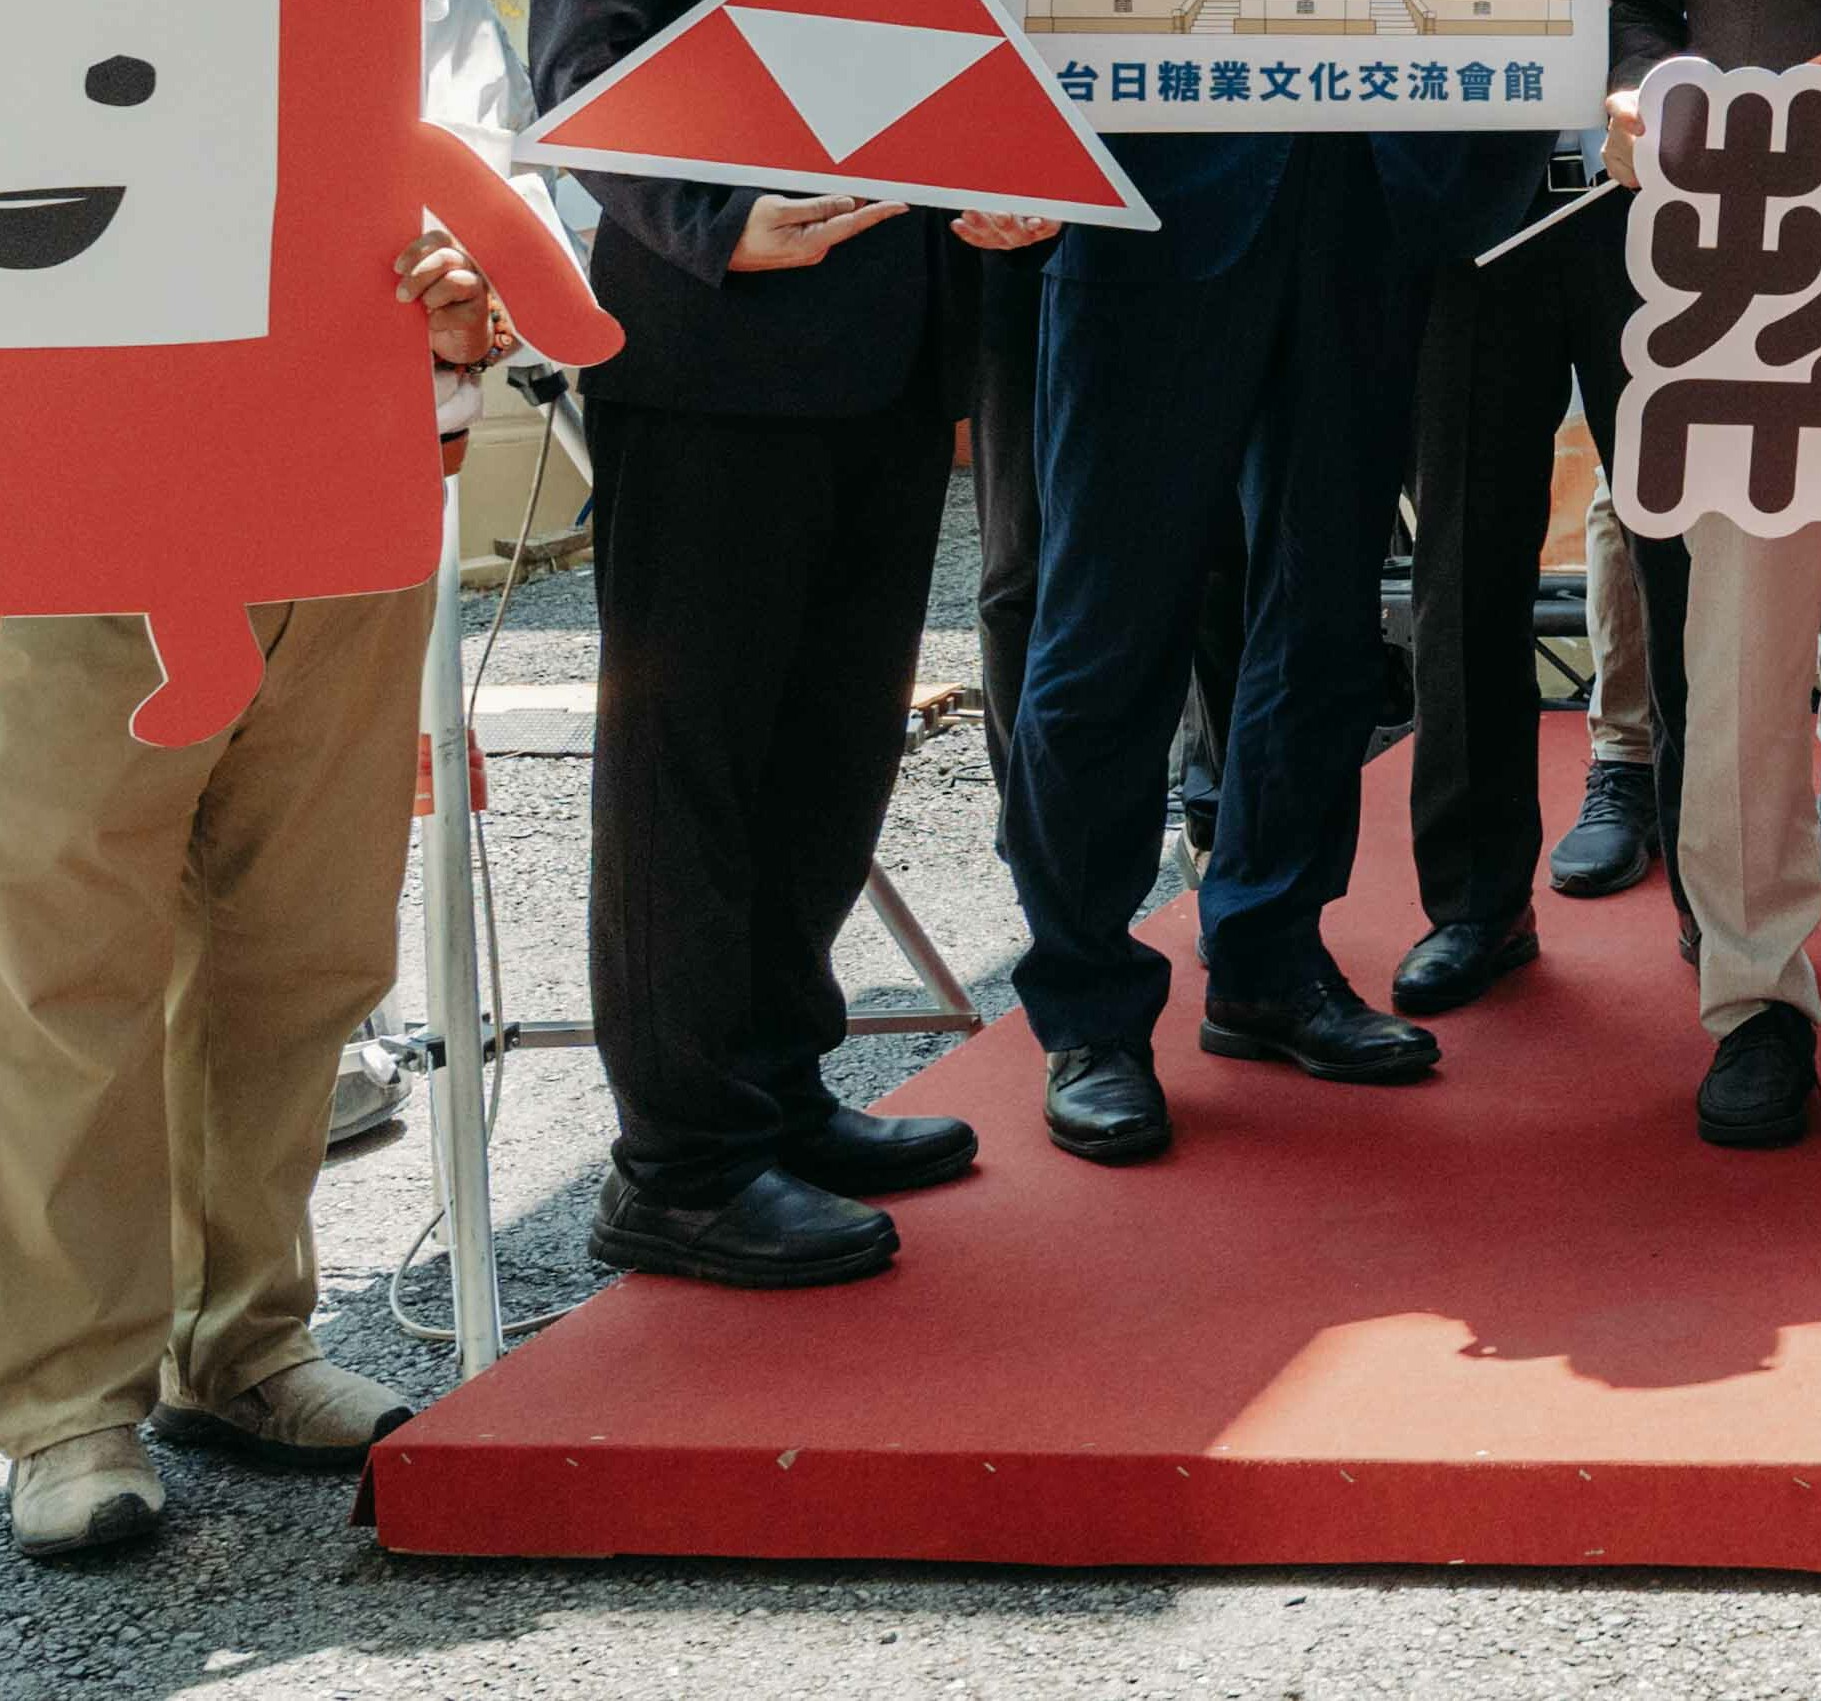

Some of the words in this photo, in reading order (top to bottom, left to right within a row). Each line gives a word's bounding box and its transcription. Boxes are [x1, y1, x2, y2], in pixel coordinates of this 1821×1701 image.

[1057, 61, 1545, 102] 台日糖業文化交流會館
